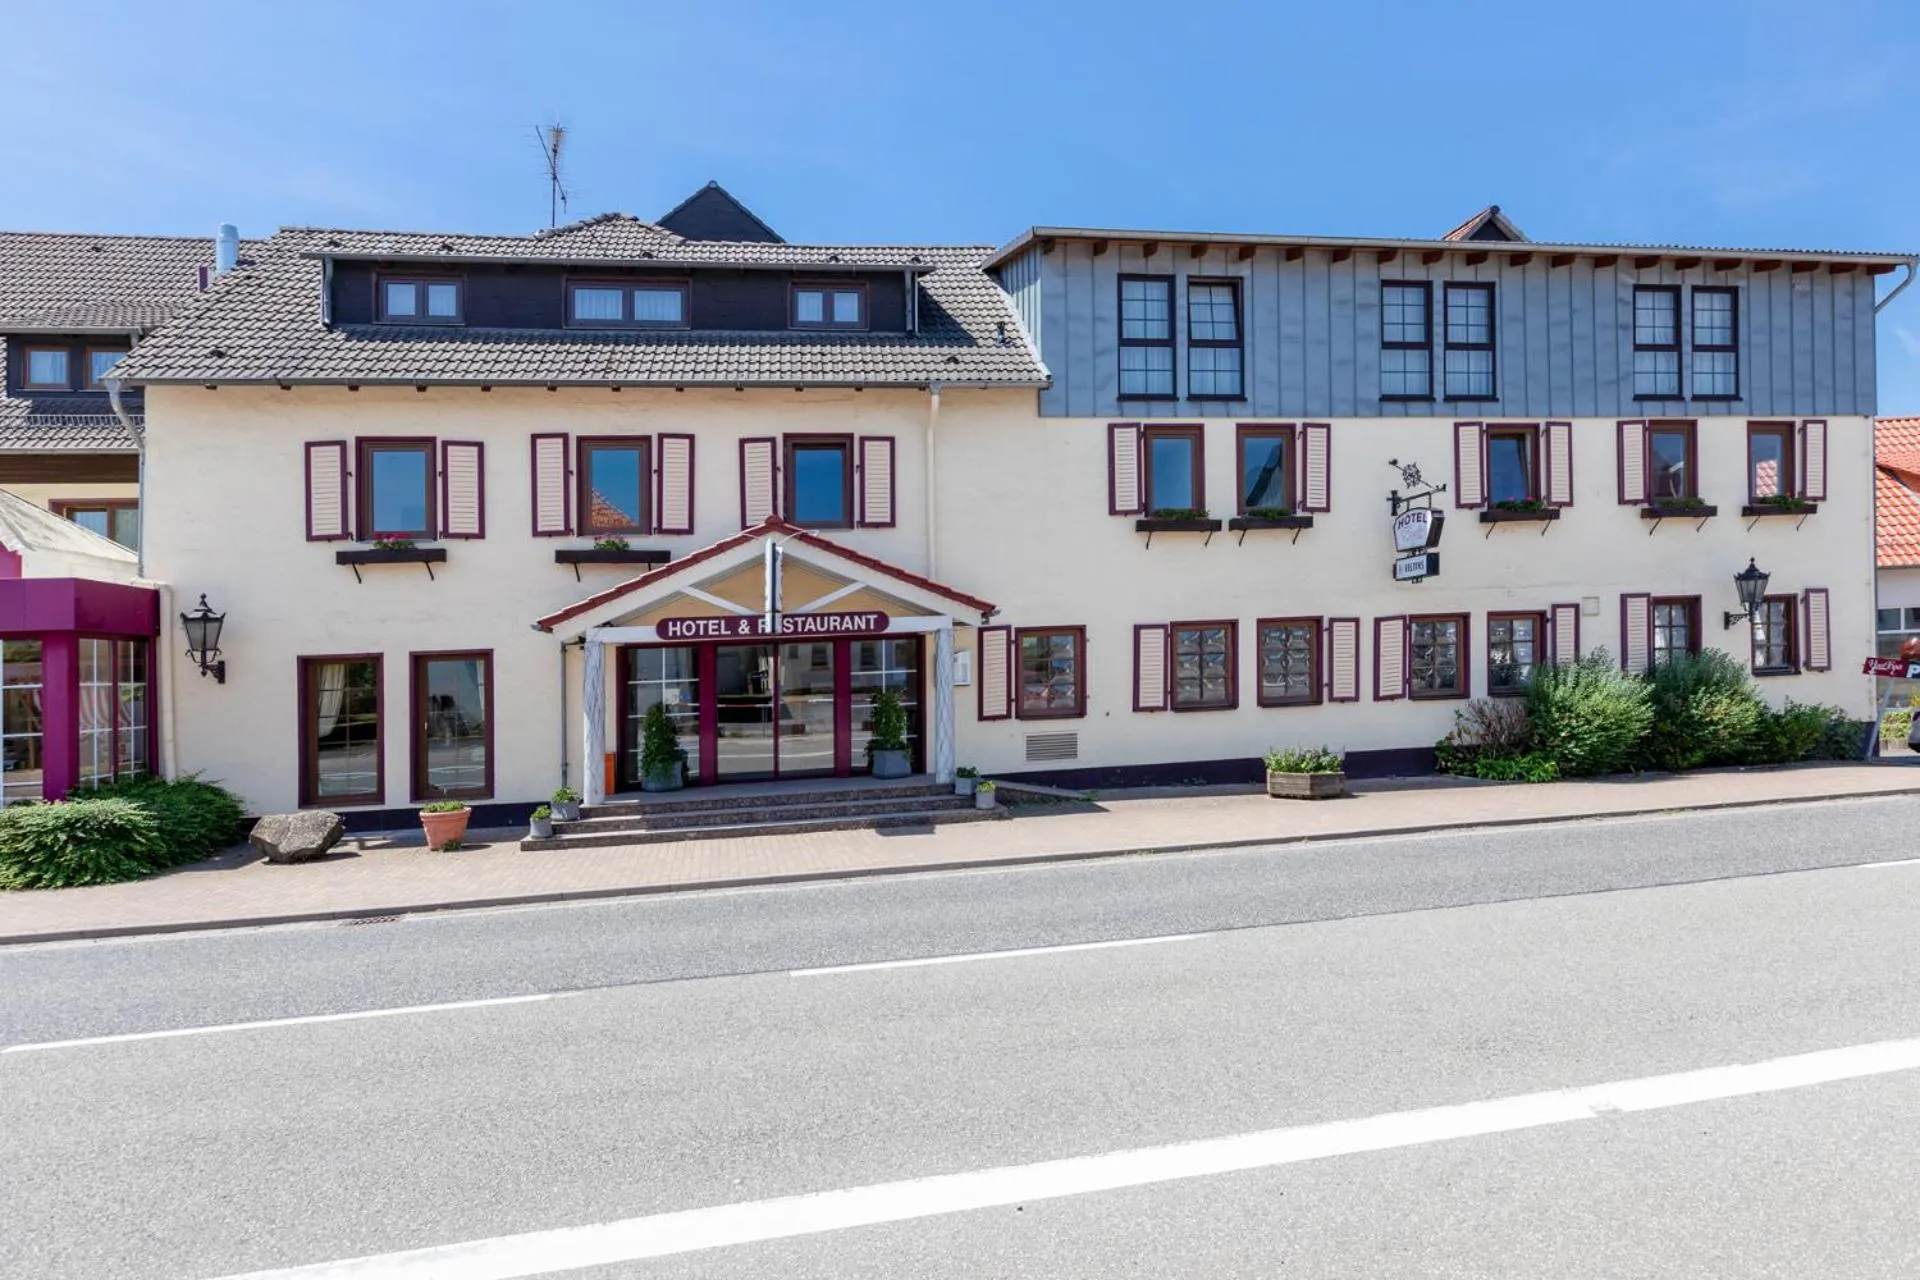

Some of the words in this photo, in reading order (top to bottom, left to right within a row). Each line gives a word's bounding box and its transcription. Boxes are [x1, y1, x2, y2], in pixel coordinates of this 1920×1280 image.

[1398, 512, 1427, 529] HOTEL
[668, 619, 731, 637] HOTEL
[738, 619, 751, 634] &
[757, 614, 878, 634] RSTAURANT
